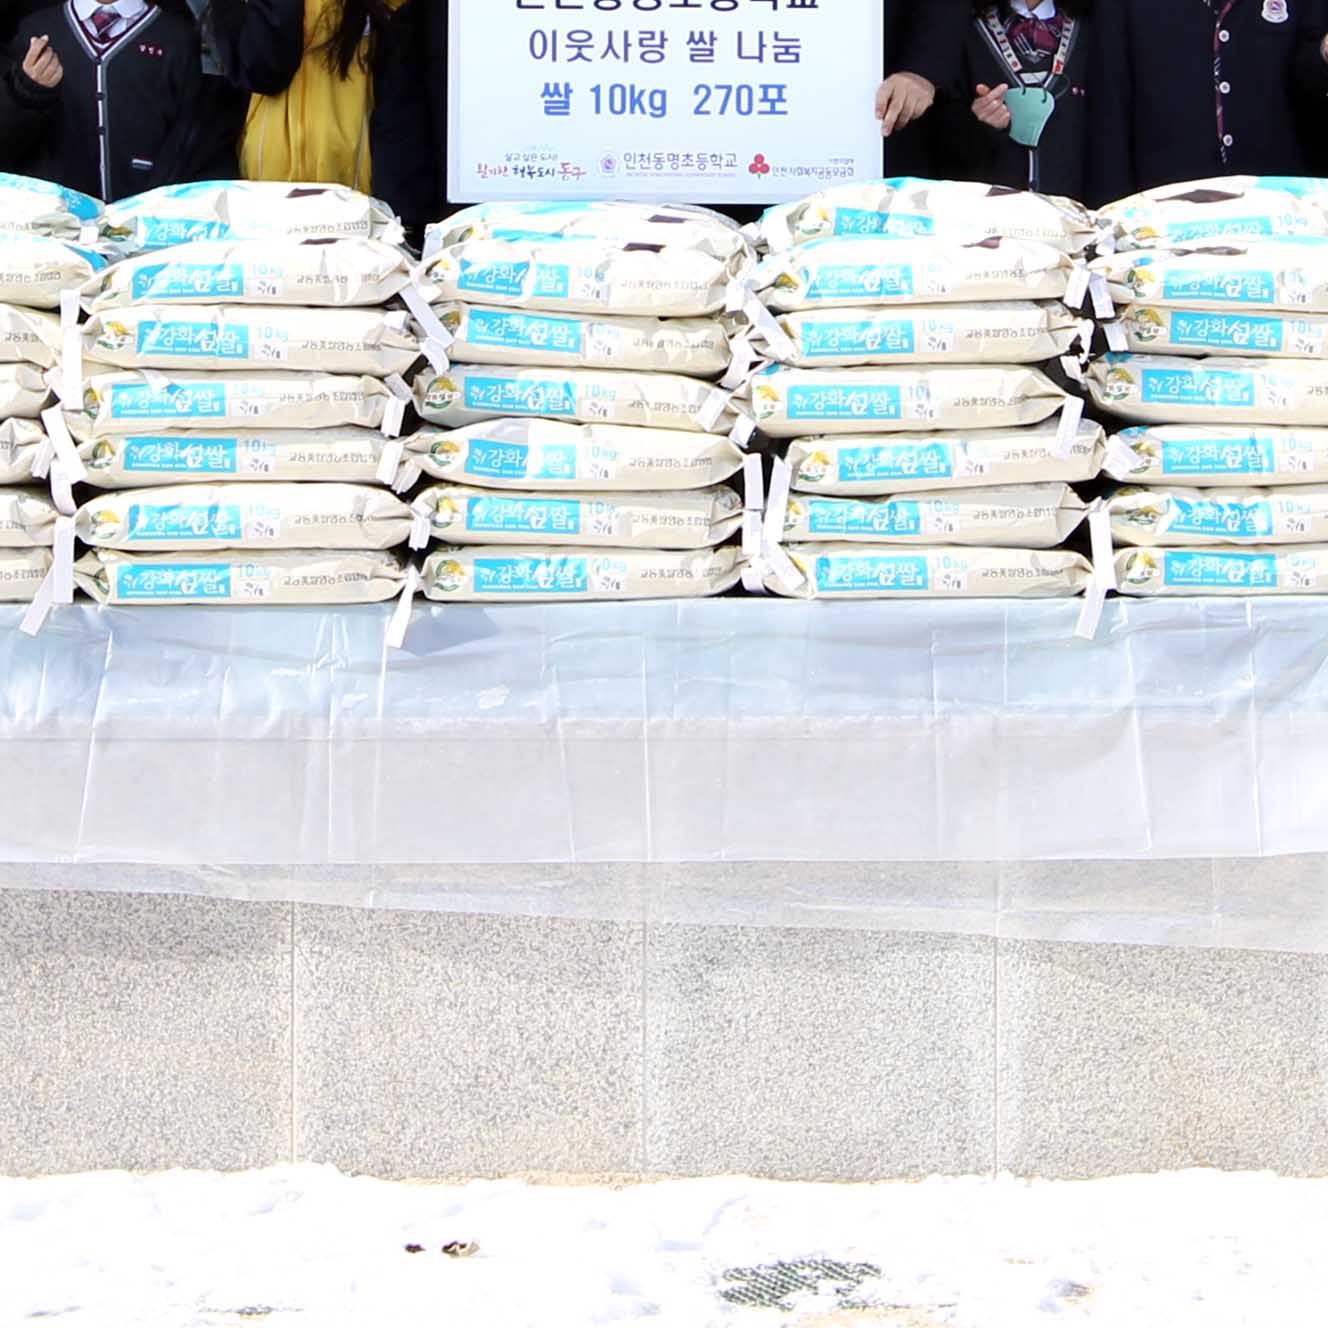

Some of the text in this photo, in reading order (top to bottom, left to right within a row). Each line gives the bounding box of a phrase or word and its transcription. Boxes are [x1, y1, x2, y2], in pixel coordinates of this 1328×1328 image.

[529, 29, 801, 64] 이웃사랑 쌀 나눔
[540, 82, 789, 118] 쌀 10kg 270포
[557, 160, 587, 182] 동구
[623, 152, 738, 171] 인천동명초등학교
[934, 556, 969, 573] 10kg
